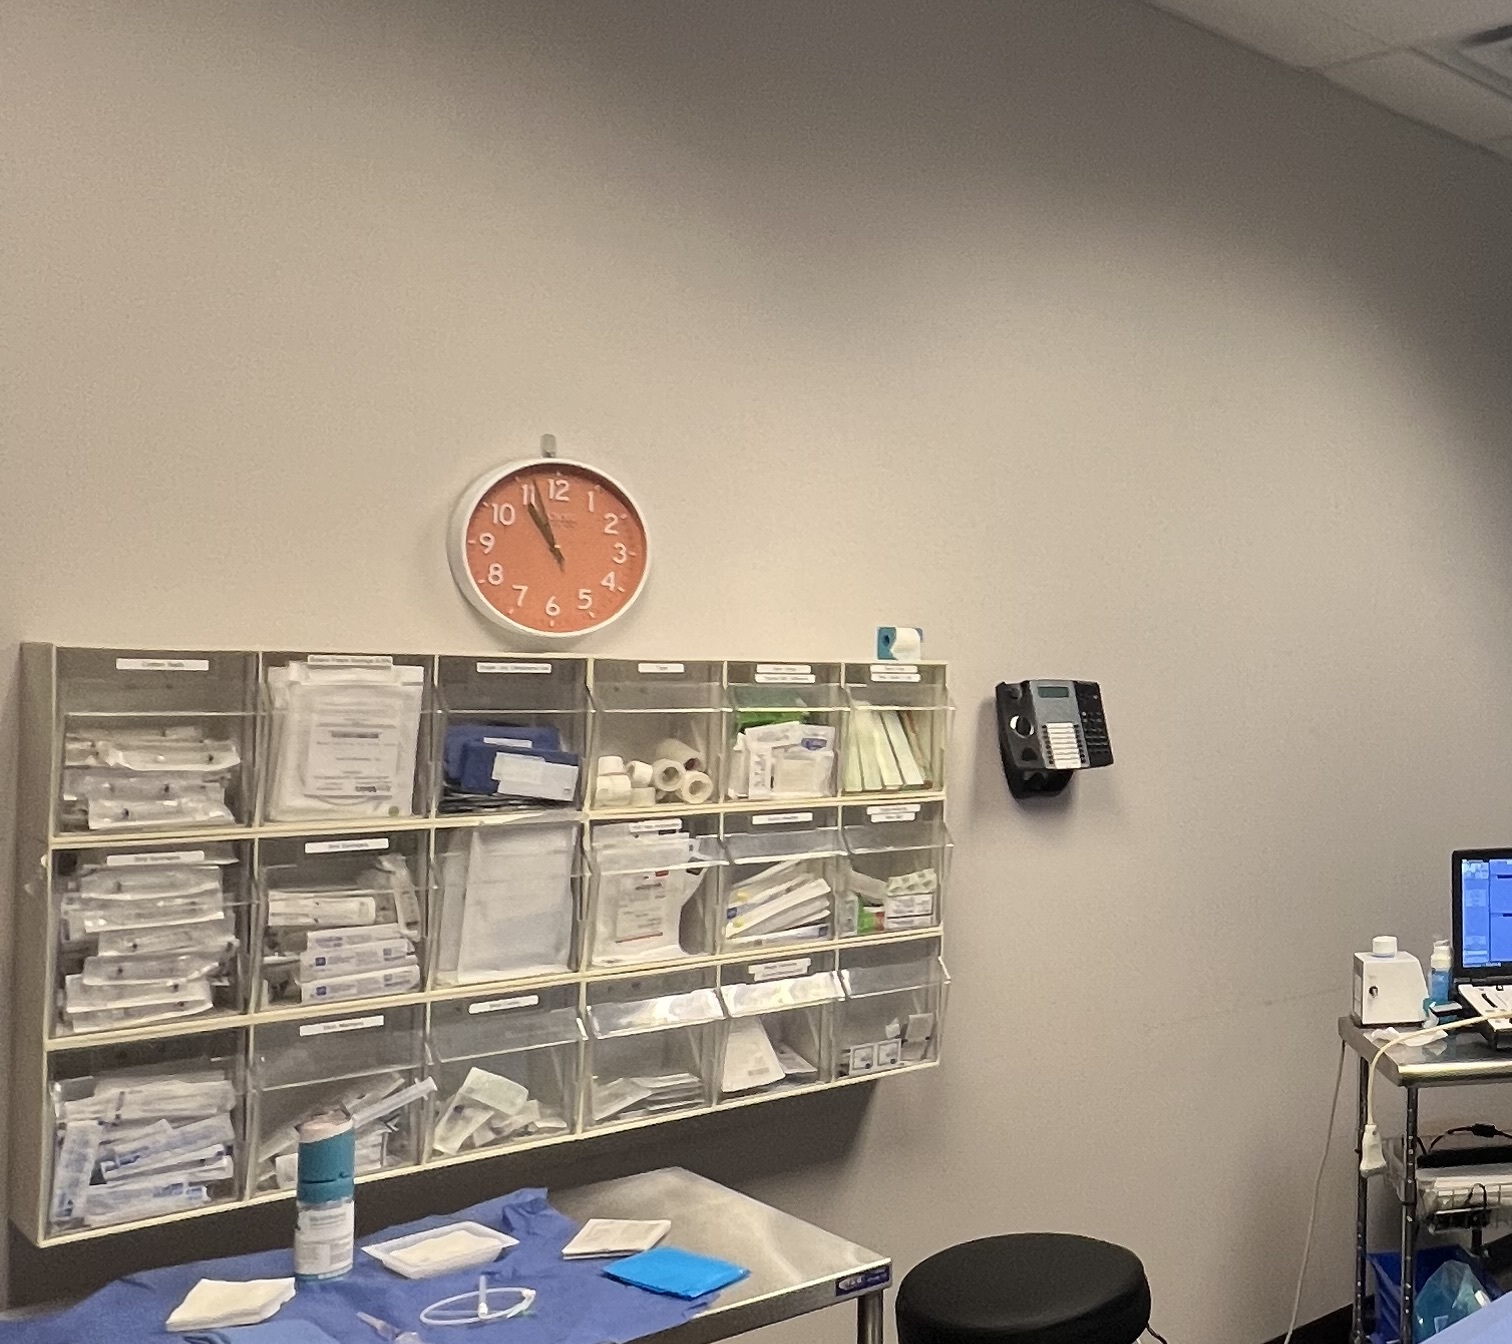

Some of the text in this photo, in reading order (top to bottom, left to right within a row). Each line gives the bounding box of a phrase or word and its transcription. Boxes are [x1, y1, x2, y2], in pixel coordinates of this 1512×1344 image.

[521, 483, 536, 506] 11
[548, 478, 570, 502] 12
[587, 490, 594, 513] 1
[491, 502, 516, 526] 10
[603, 512, 619, 536] 2
[479, 532, 496, 555] 9
[612, 542, 627, 564] 3
[487, 563, 504, 586] 8
[600, 570, 616, 593] 4
[512, 584, 529, 607] 7
[544, 595, 561, 616] 6
[577, 588, 593, 610] 5
